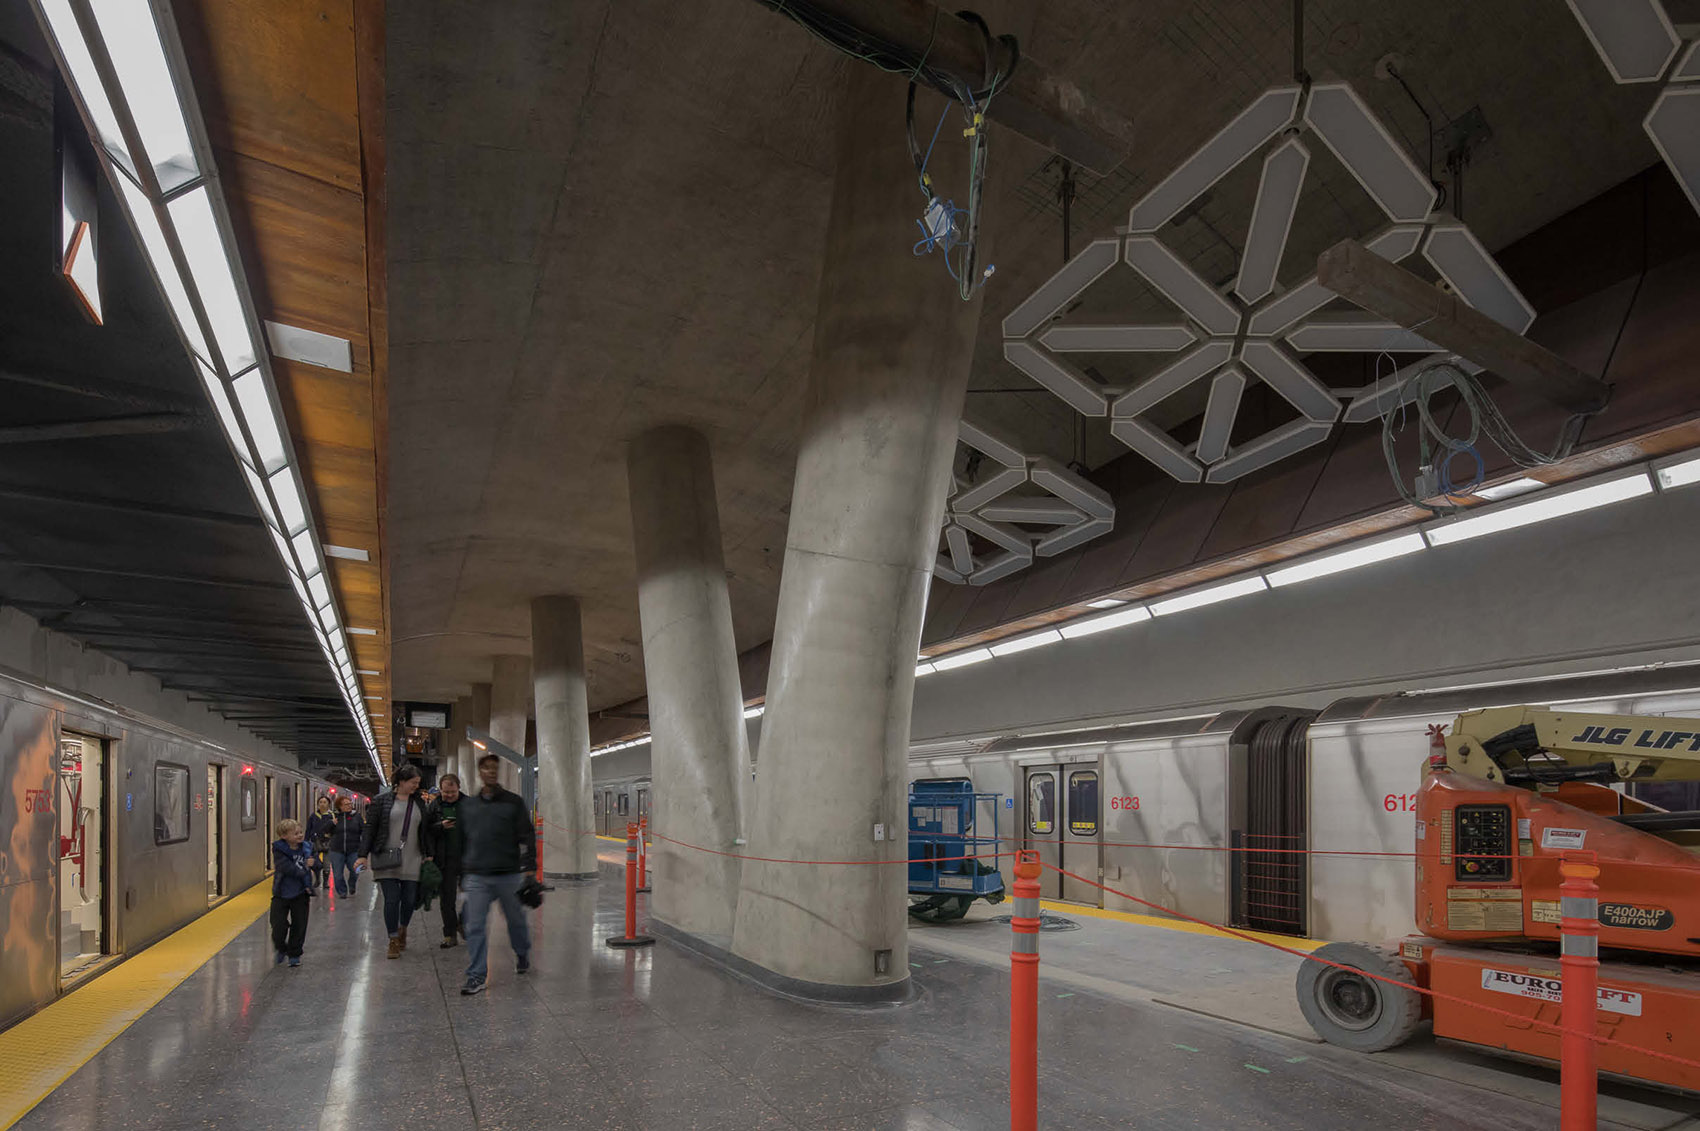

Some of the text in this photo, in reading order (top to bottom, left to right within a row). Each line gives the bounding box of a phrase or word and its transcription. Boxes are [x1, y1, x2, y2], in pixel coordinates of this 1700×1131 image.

[1571, 726, 1700, 752] JLG LIFT
[25, 788, 51, 813] 5753
[1111, 796, 1140, 810] 6123
[1384, 793, 1416, 812] 612
[1604, 905, 1666, 919] E400AJP
[1610, 915, 1659, 927] narrow
[1597, 989, 1636, 1003] FT
